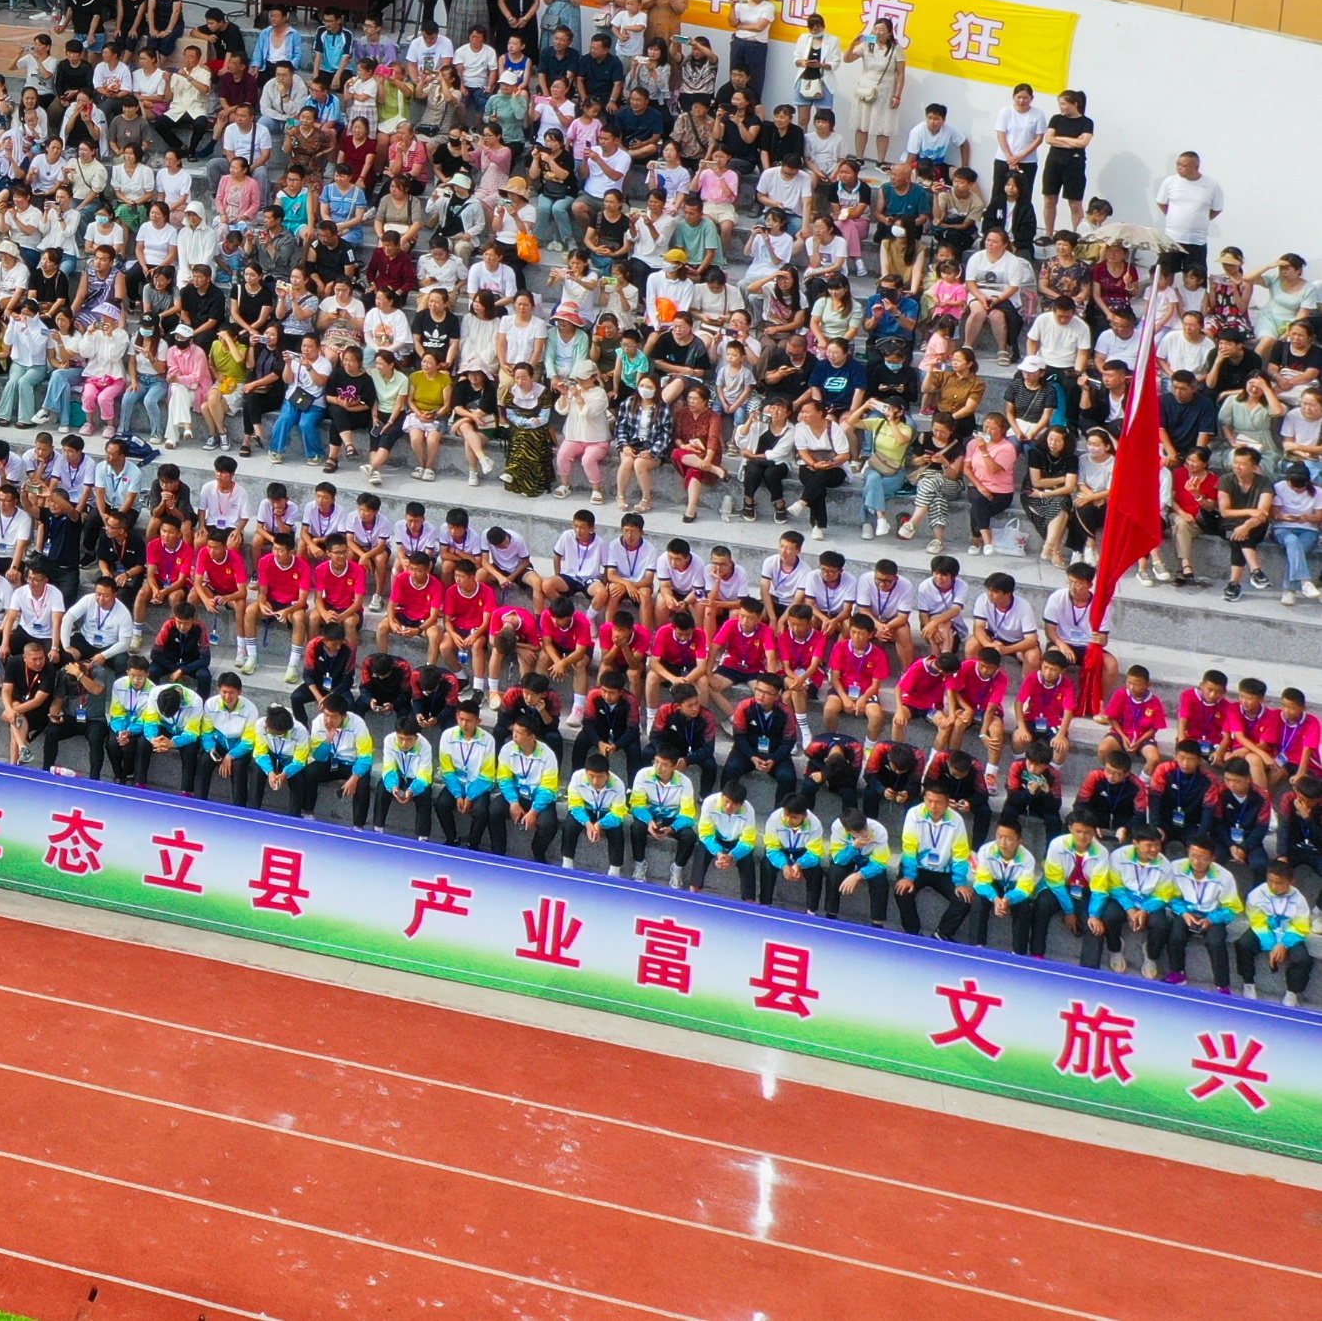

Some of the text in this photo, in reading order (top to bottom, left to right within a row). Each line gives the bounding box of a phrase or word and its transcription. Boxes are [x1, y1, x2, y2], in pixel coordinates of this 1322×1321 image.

[403, 876, 820, 1019] 产业富县
[928, 979, 1270, 1112] 文旅兴
